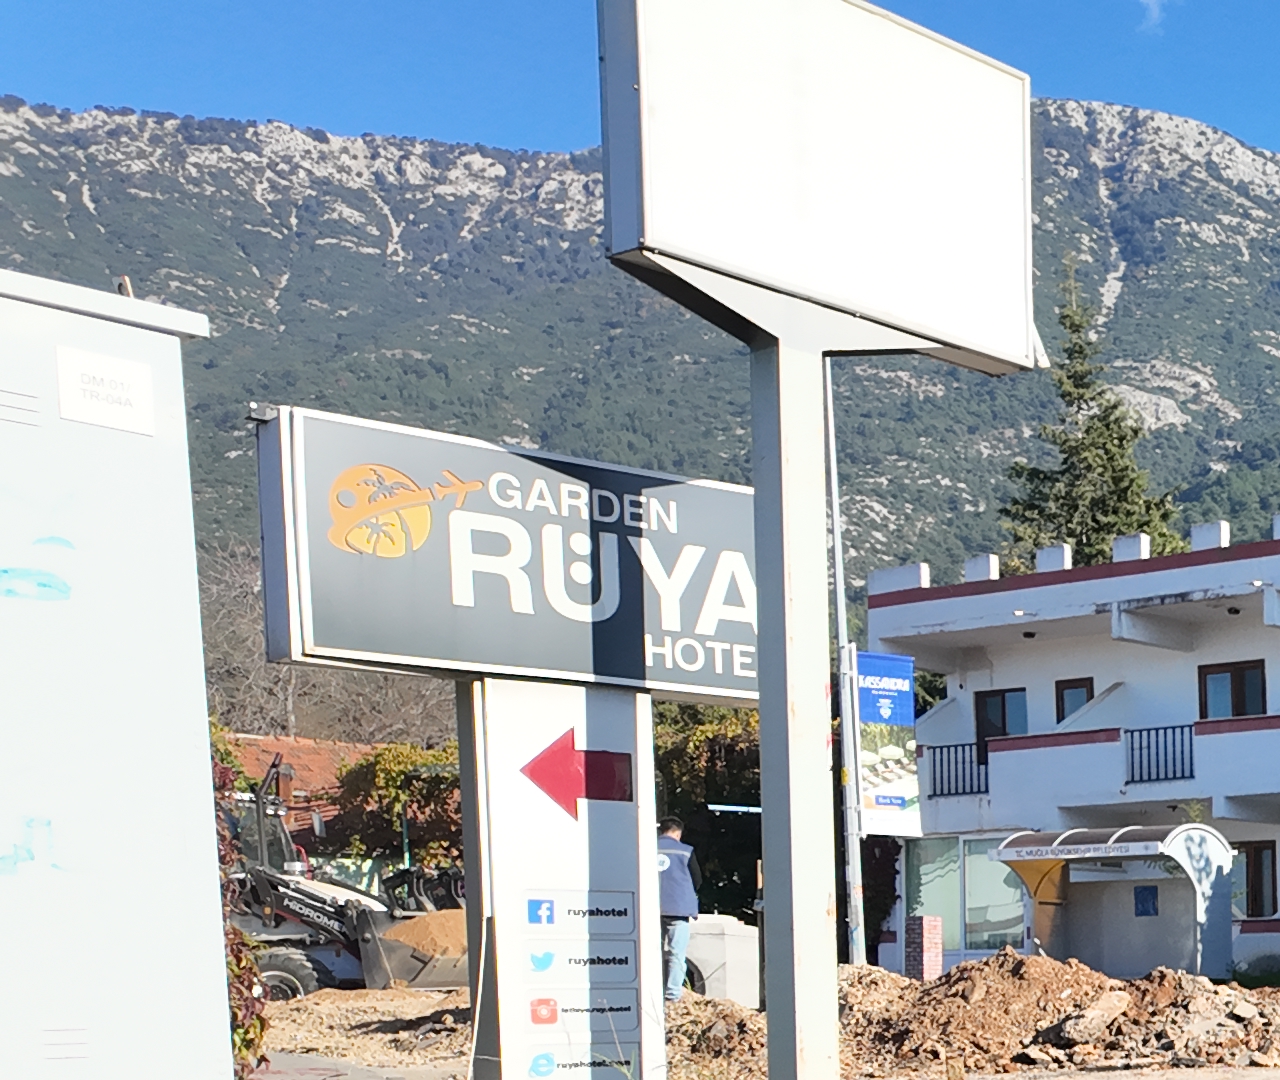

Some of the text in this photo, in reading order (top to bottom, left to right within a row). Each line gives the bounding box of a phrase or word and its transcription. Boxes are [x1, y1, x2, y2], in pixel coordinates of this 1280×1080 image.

[80, 372, 105, 388] DM
[79, 387, 134, 409] TR-04A
[487, 472, 678, 534] GARDEN
[448, 509, 758, 636] RÜYA
[644, 633, 757, 678] HOTE
[567, 907, 628, 918] ruyahotel
[568, 956, 629, 966] ruyahotel
